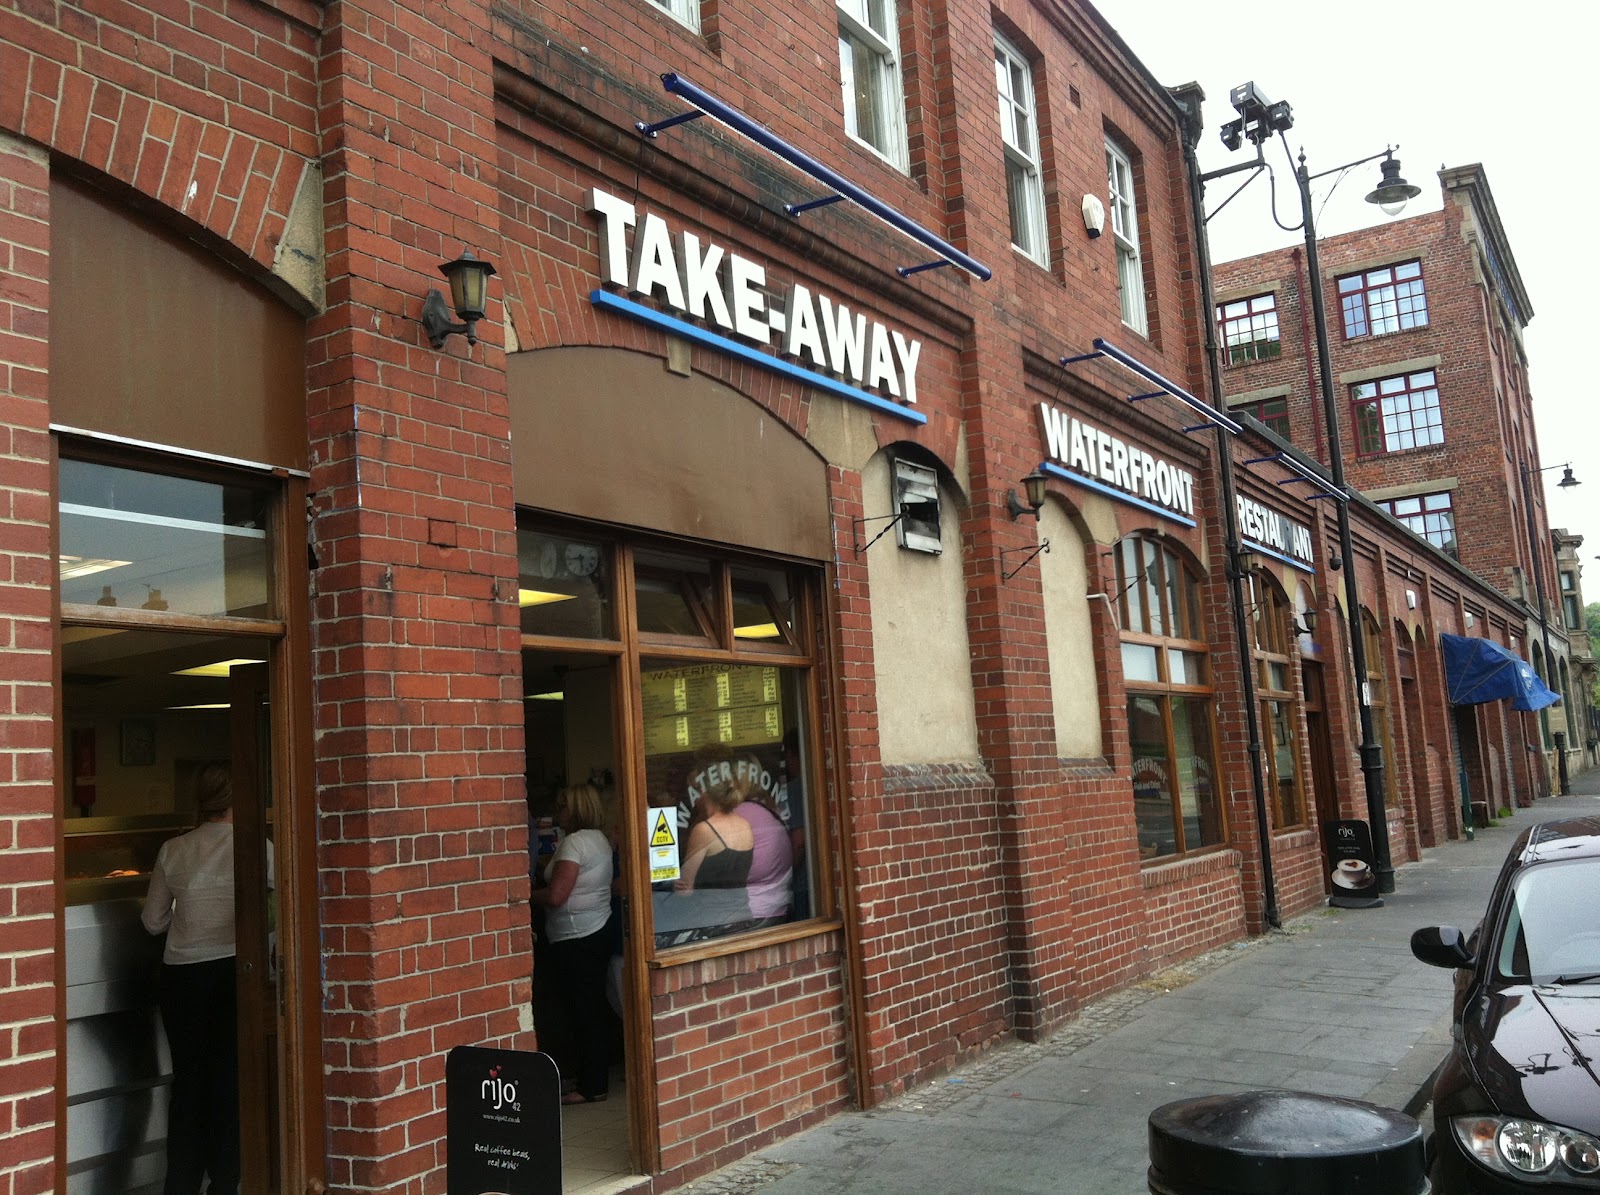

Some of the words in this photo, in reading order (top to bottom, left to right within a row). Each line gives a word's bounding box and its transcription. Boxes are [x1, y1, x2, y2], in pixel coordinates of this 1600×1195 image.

[590, 187, 921, 403] TAKE-AWAY
[1038, 402, 1194, 515] WATERFRONT
[1236, 494, 1314, 563] RESTAURANT
[677, 760, 792, 829] WATERFRONT
[482, 1078, 516, 1110] rijo
[512, 1102, 521, 1112] 42
[475, 1143, 490, 1154] Real
[490, 1145, 511, 1156] coffee
[487, 1159, 500, 1168] real
